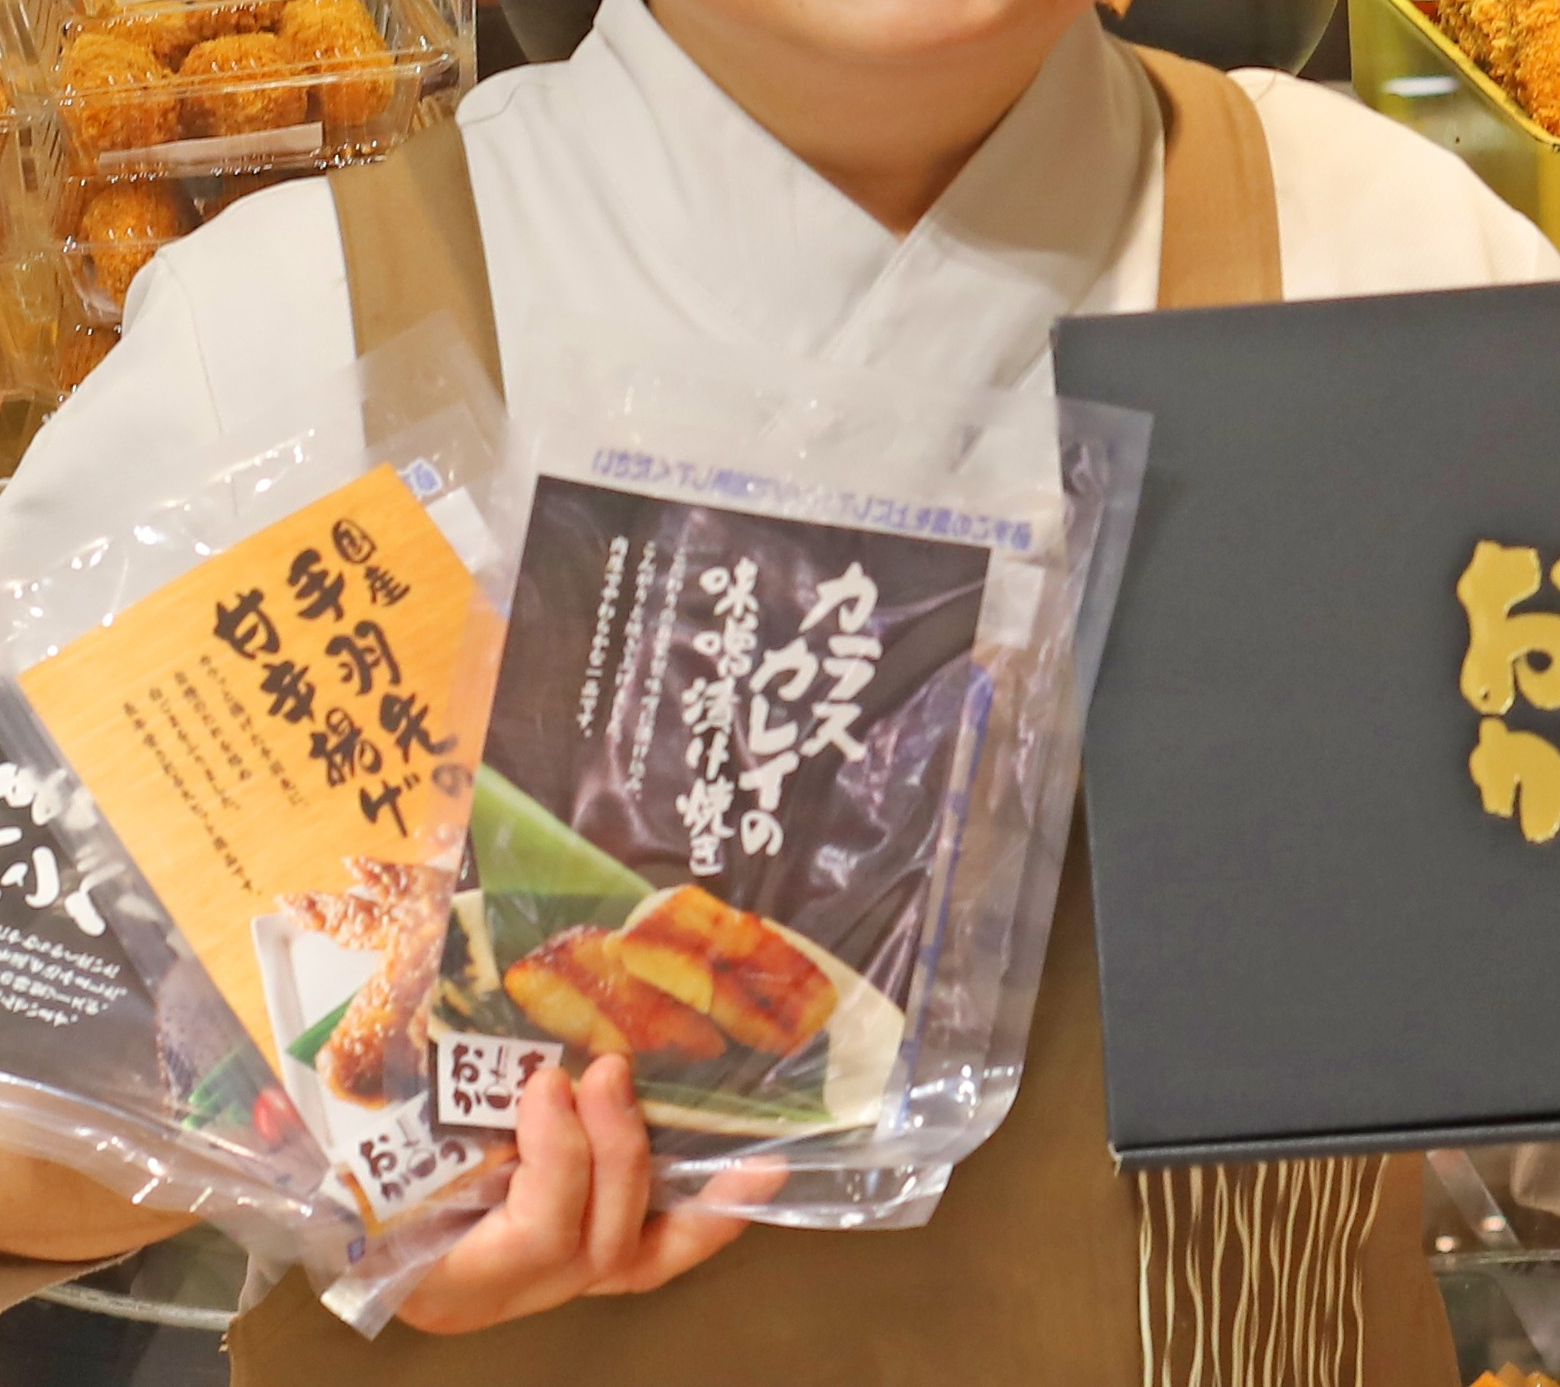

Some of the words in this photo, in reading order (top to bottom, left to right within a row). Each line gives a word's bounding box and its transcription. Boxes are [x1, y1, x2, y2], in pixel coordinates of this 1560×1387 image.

[676, 555, 761, 878] 味噌漬け焼き
[739, 636, 819, 858] カレイの
[798, 561, 884, 763] カラス
